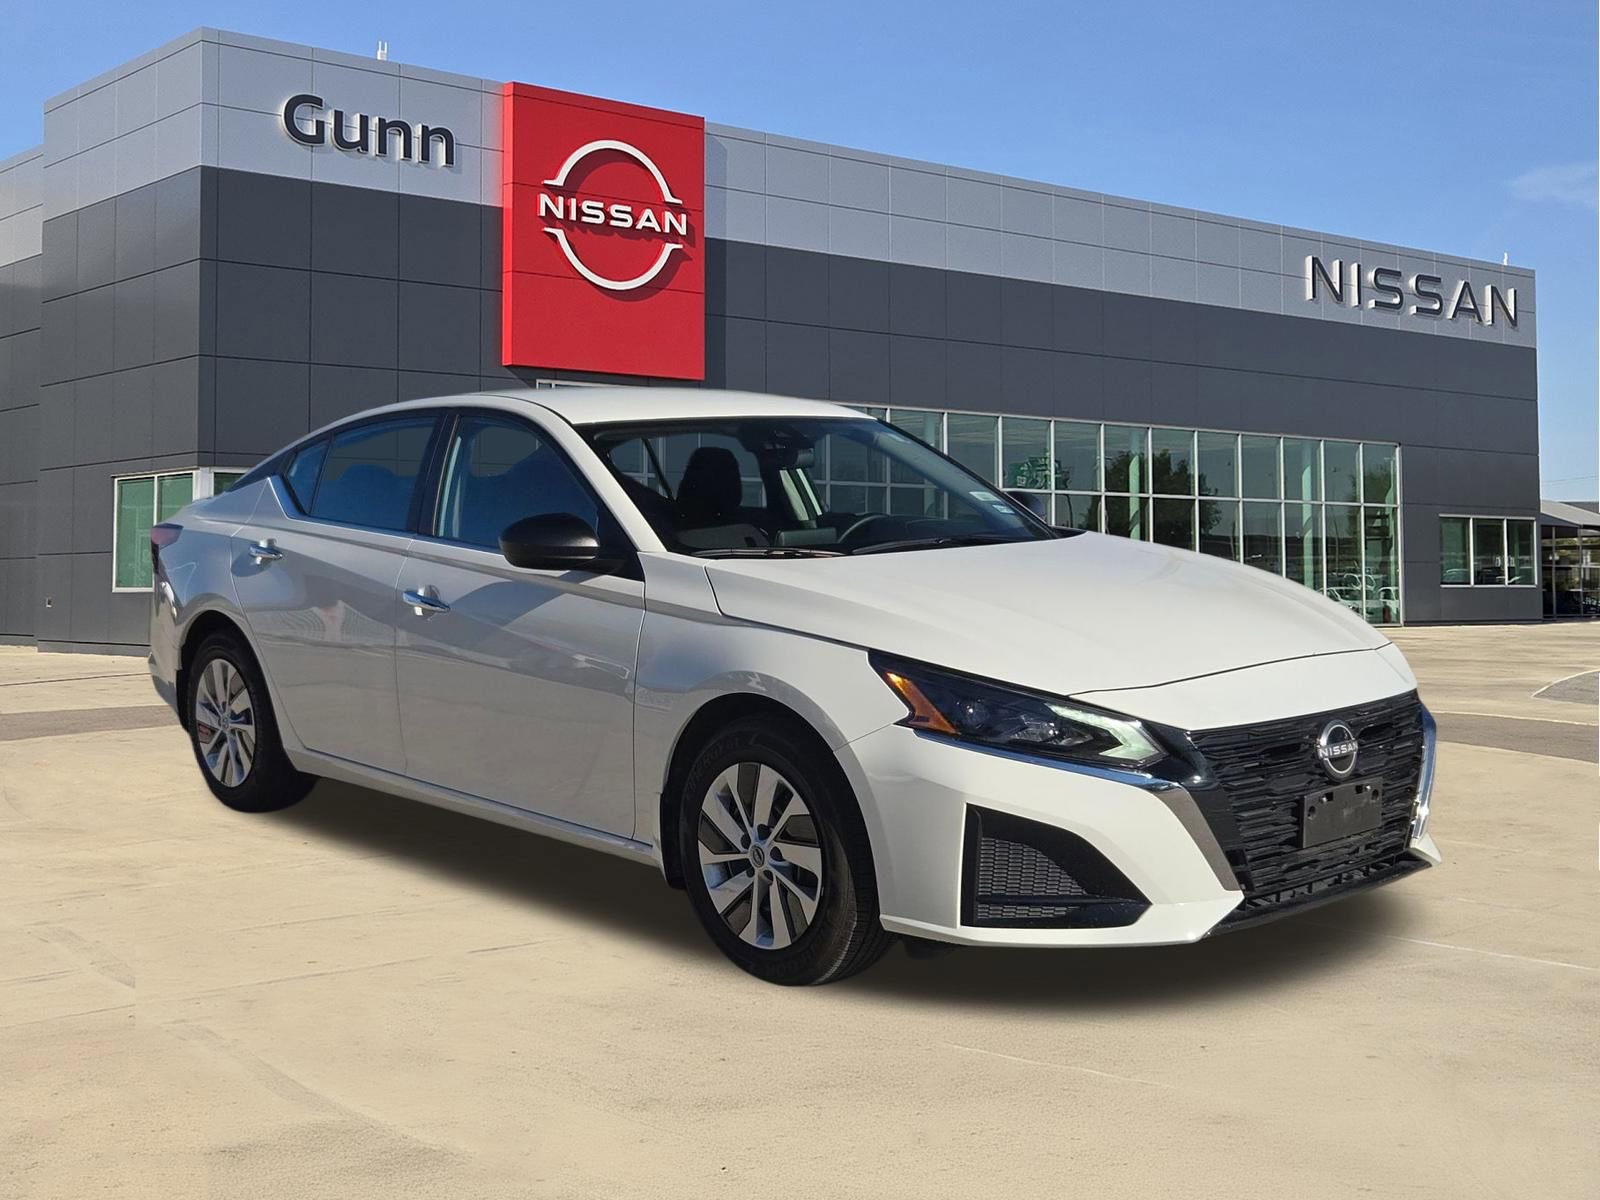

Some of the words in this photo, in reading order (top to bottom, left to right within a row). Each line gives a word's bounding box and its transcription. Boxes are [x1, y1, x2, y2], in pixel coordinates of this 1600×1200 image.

[282, 94, 455, 167] Gunn
[538, 193, 687, 235] NISSAN
[1304, 255, 1518, 327] NISSAN
[1319, 742, 1358, 758] NISSAN
